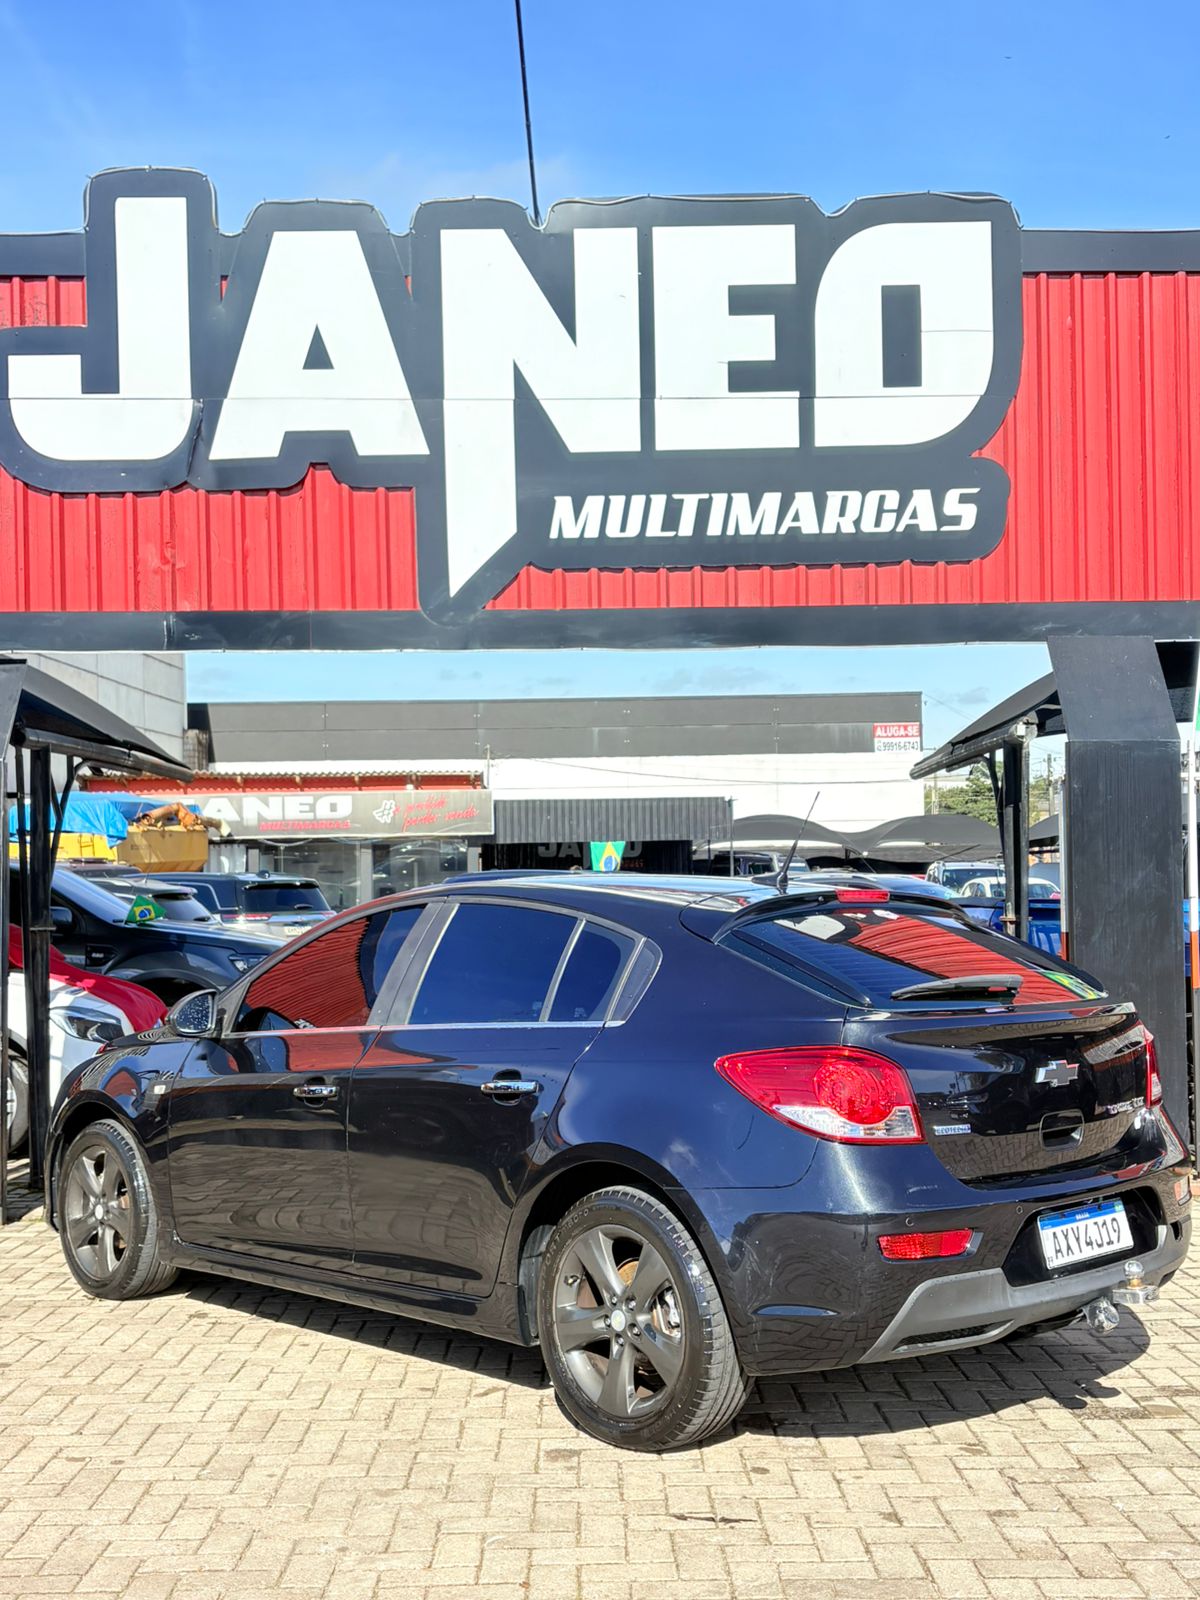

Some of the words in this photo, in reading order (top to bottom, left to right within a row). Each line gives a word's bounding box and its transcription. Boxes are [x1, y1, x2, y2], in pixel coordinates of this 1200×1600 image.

[8, 197, 994, 598] JANEO
[549, 488, 981, 539] MULTIMARCAS
[875, 725, 920, 737] ALUGA-SE
[184, 795, 353, 827] ANEO
[1052, 1216, 1121, 1260] AXY4J19
